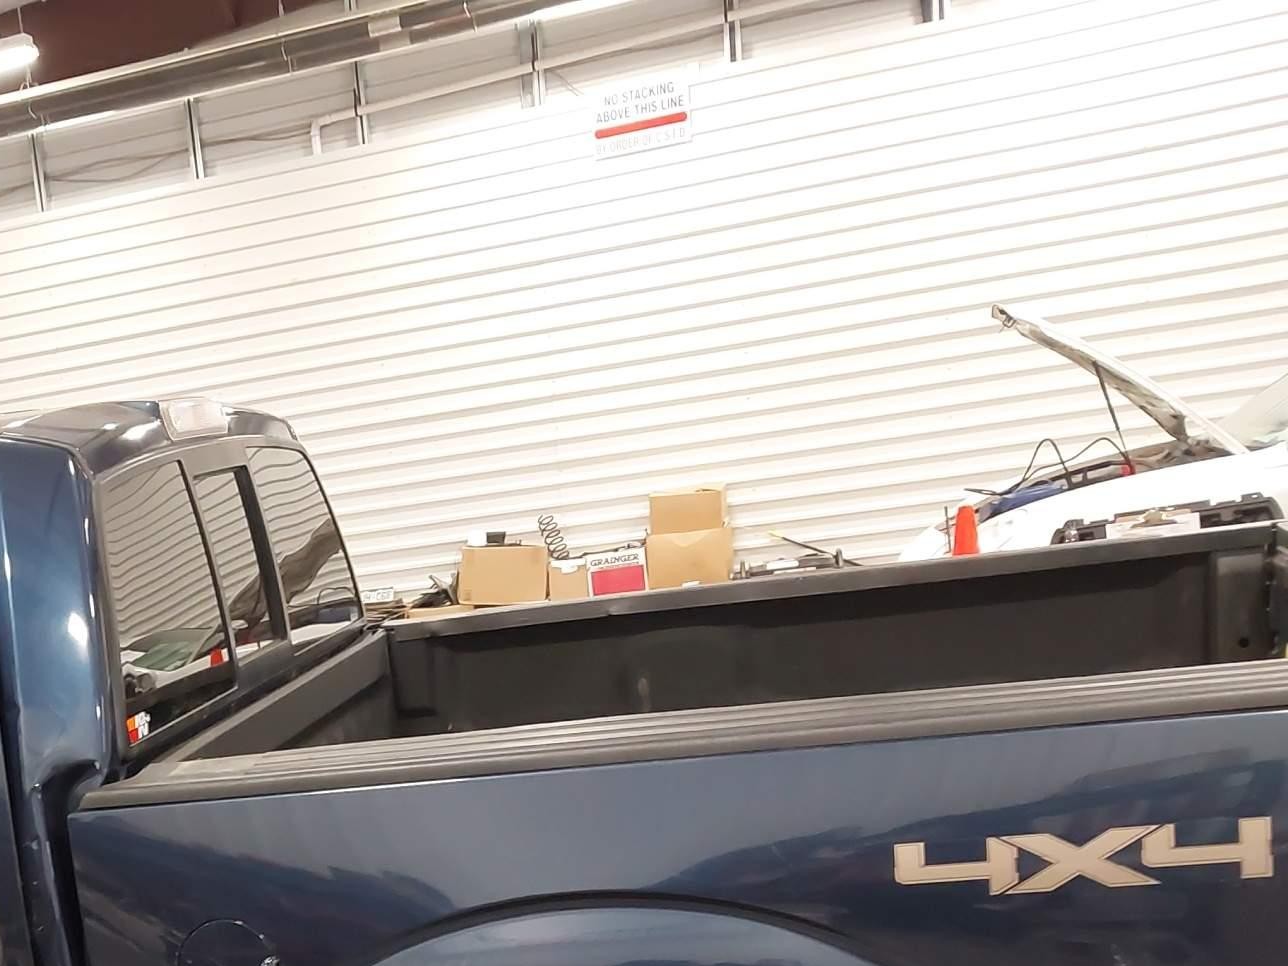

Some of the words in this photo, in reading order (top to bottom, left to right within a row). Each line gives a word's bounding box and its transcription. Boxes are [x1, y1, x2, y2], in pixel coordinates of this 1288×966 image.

[604, 94, 618, 106] NO
[621, 81, 674, 103] STACKING
[596, 106, 630, 123] ABOVE
[634, 100, 657, 114] THIS
[661, 94, 684, 110] LINE
[590, 553, 640, 567] GRAINGER
